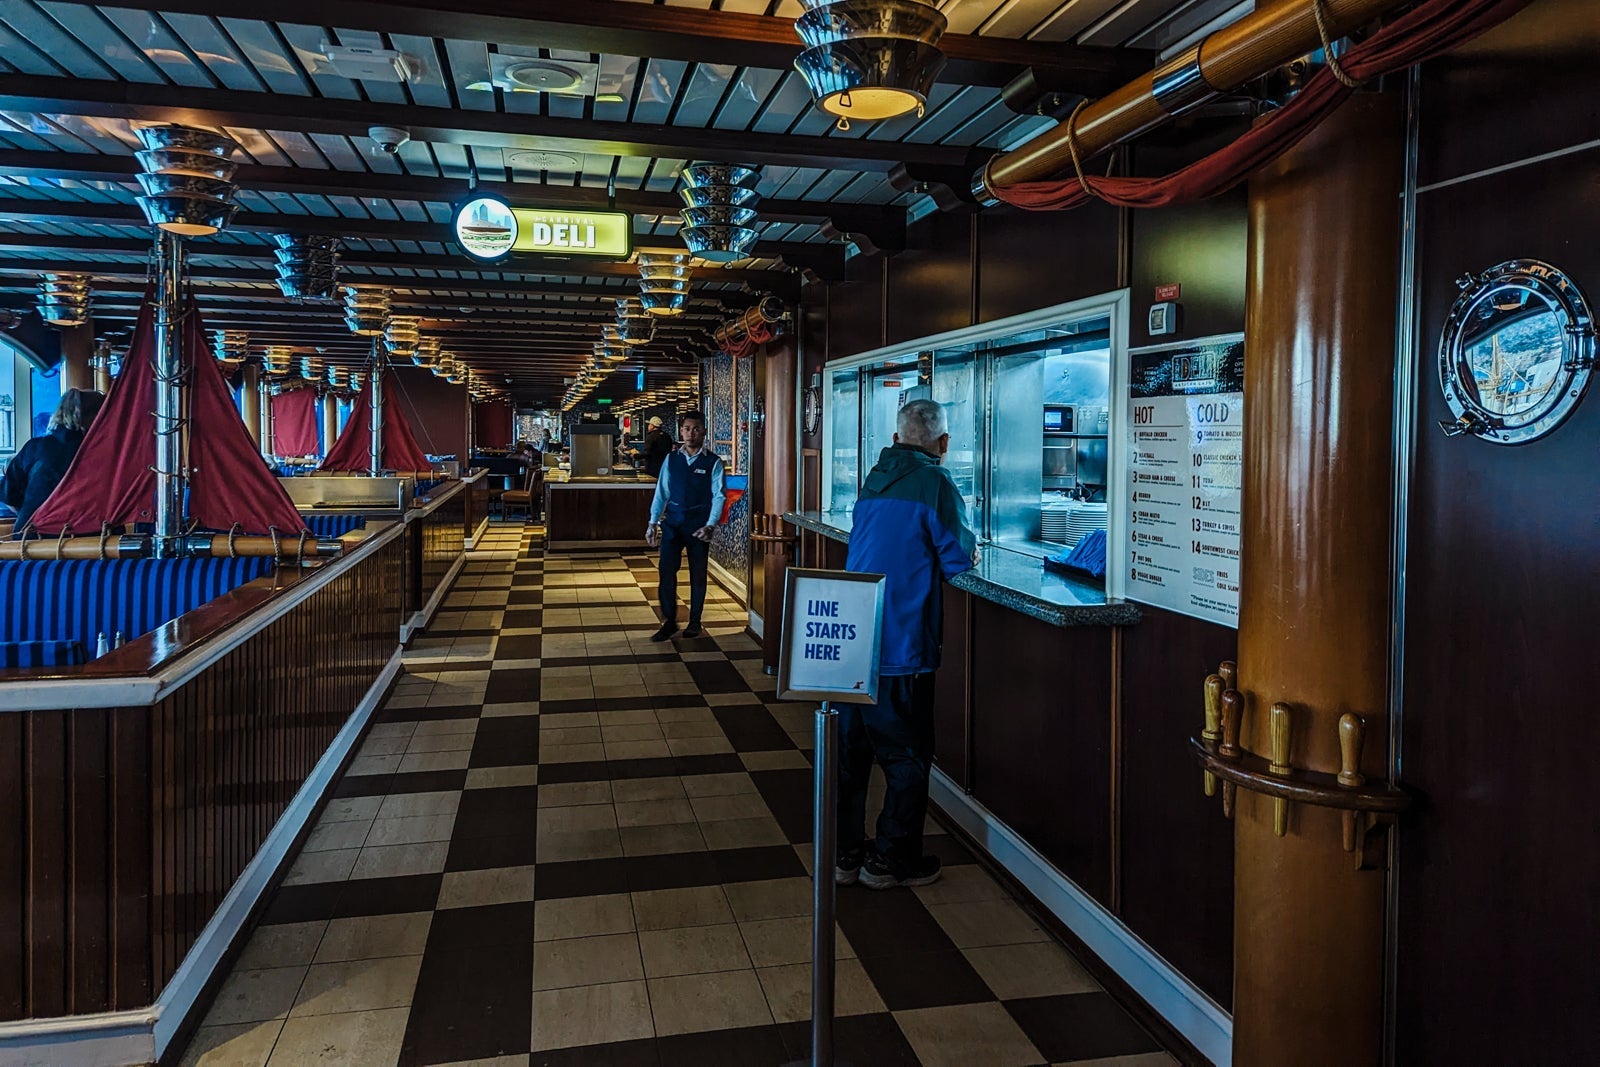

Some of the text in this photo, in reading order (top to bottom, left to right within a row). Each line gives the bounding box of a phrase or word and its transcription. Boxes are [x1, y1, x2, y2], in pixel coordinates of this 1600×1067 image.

[542, 216, 594, 224] CARNIVAL
[533, 223, 596, 248] DELI
[1181, 355, 1213, 380] DELI
[1134, 406, 1154, 424] HOT
[1197, 403, 1229, 423] COLD
[1134, 432, 1136, 443] 1
[1197, 431, 1203, 443] 9
[1133, 452, 1137, 463] 2
[1193, 453, 1202, 466] 10
[1133, 471, 1137, 483] 3
[1193, 475, 1200, 488] 11
[1133, 491, 1137, 503] 4
[1192, 496, 1201, 510] 12
[1132, 511, 1137, 523] 5
[1192, 518, 1201, 532] 13
[1132, 530, 1136, 542] 6
[1192, 540, 1201, 554] 14
[1202, 544, 1225, 553] SOUTHWEST
[1132, 551, 1136, 563] 7
[1132, 568, 1136, 580] 8
[1193, 567, 1214, 583] SIDES
[807, 600, 839, 618] LINE
[806, 622, 856, 640] STARTS
[805, 643, 841, 661] HERE
